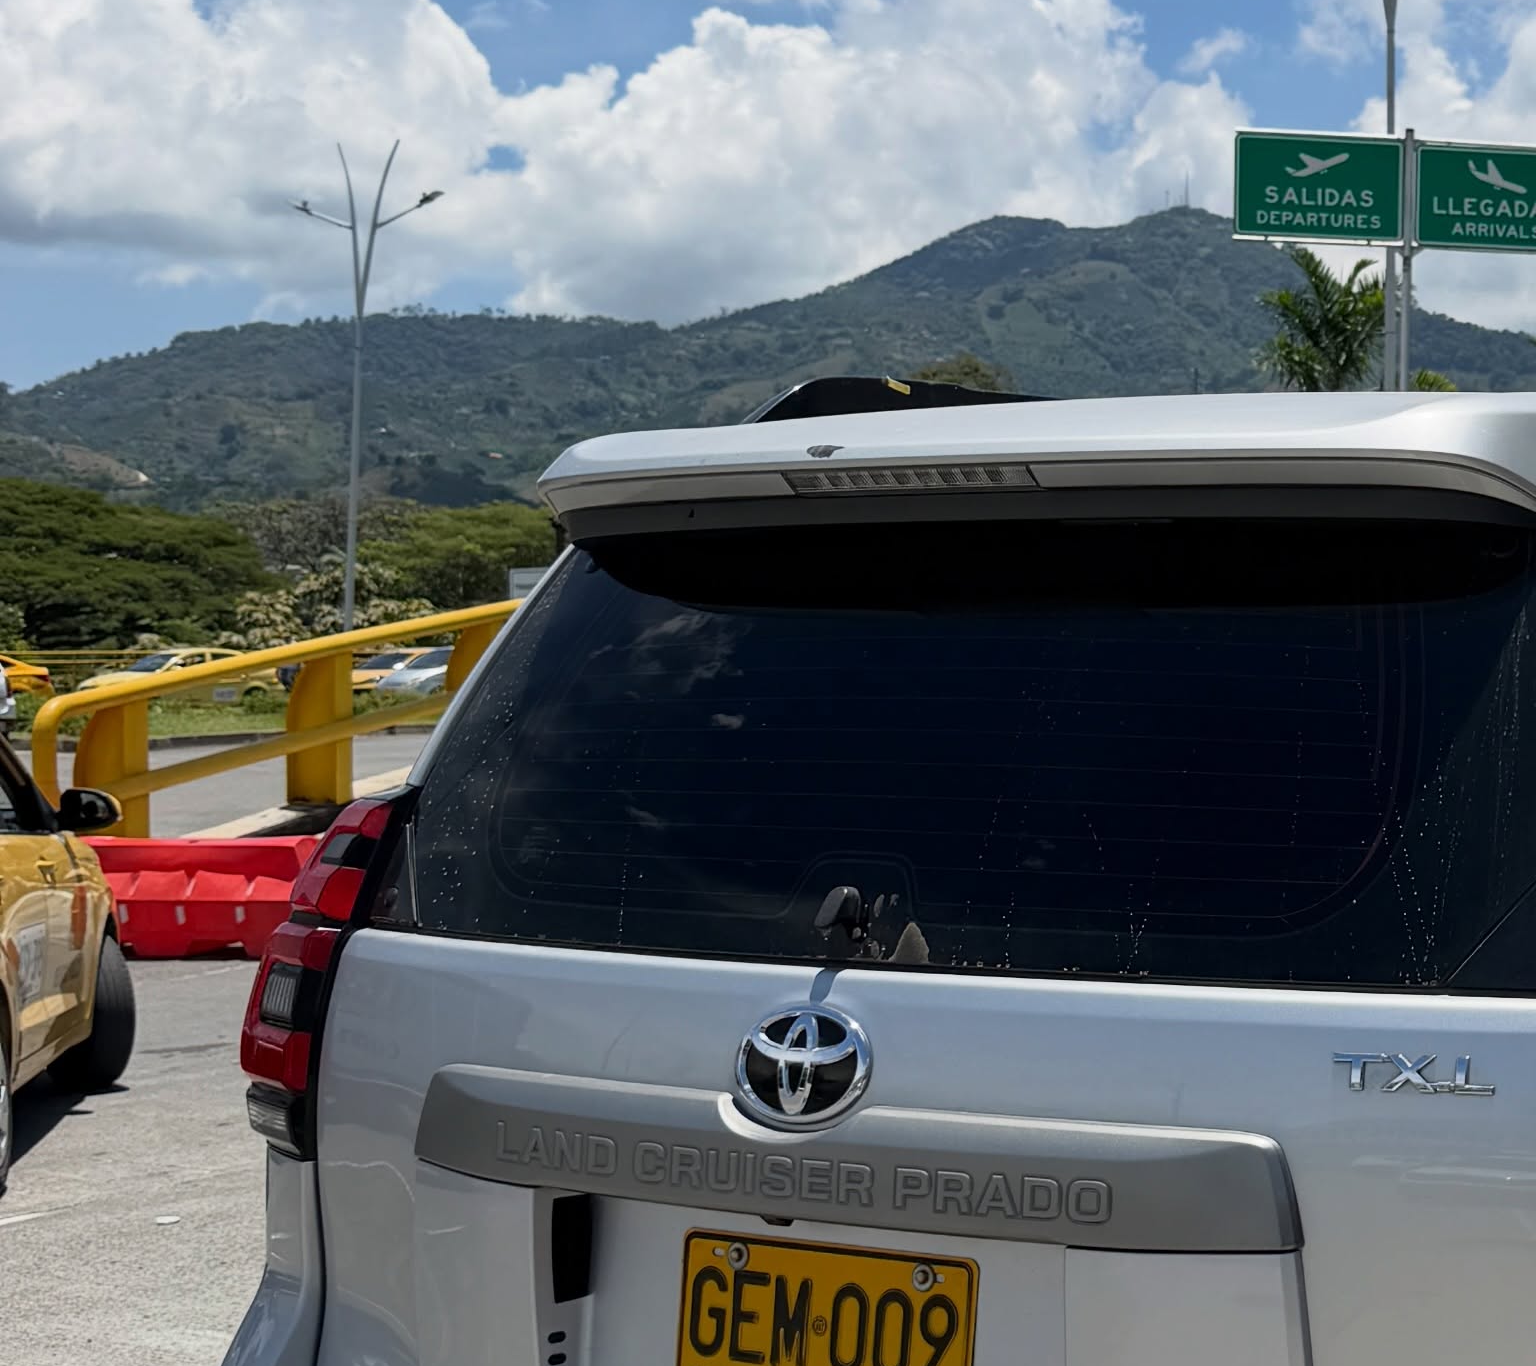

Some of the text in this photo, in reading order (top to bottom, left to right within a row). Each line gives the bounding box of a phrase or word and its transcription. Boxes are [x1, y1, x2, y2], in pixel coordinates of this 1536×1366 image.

[1264, 186, 1374, 208] SALIDAS
[1256, 209, 1382, 229] DEPARTURES
[496, 1121, 1114, 1226] LAND CRUISER PRADO
